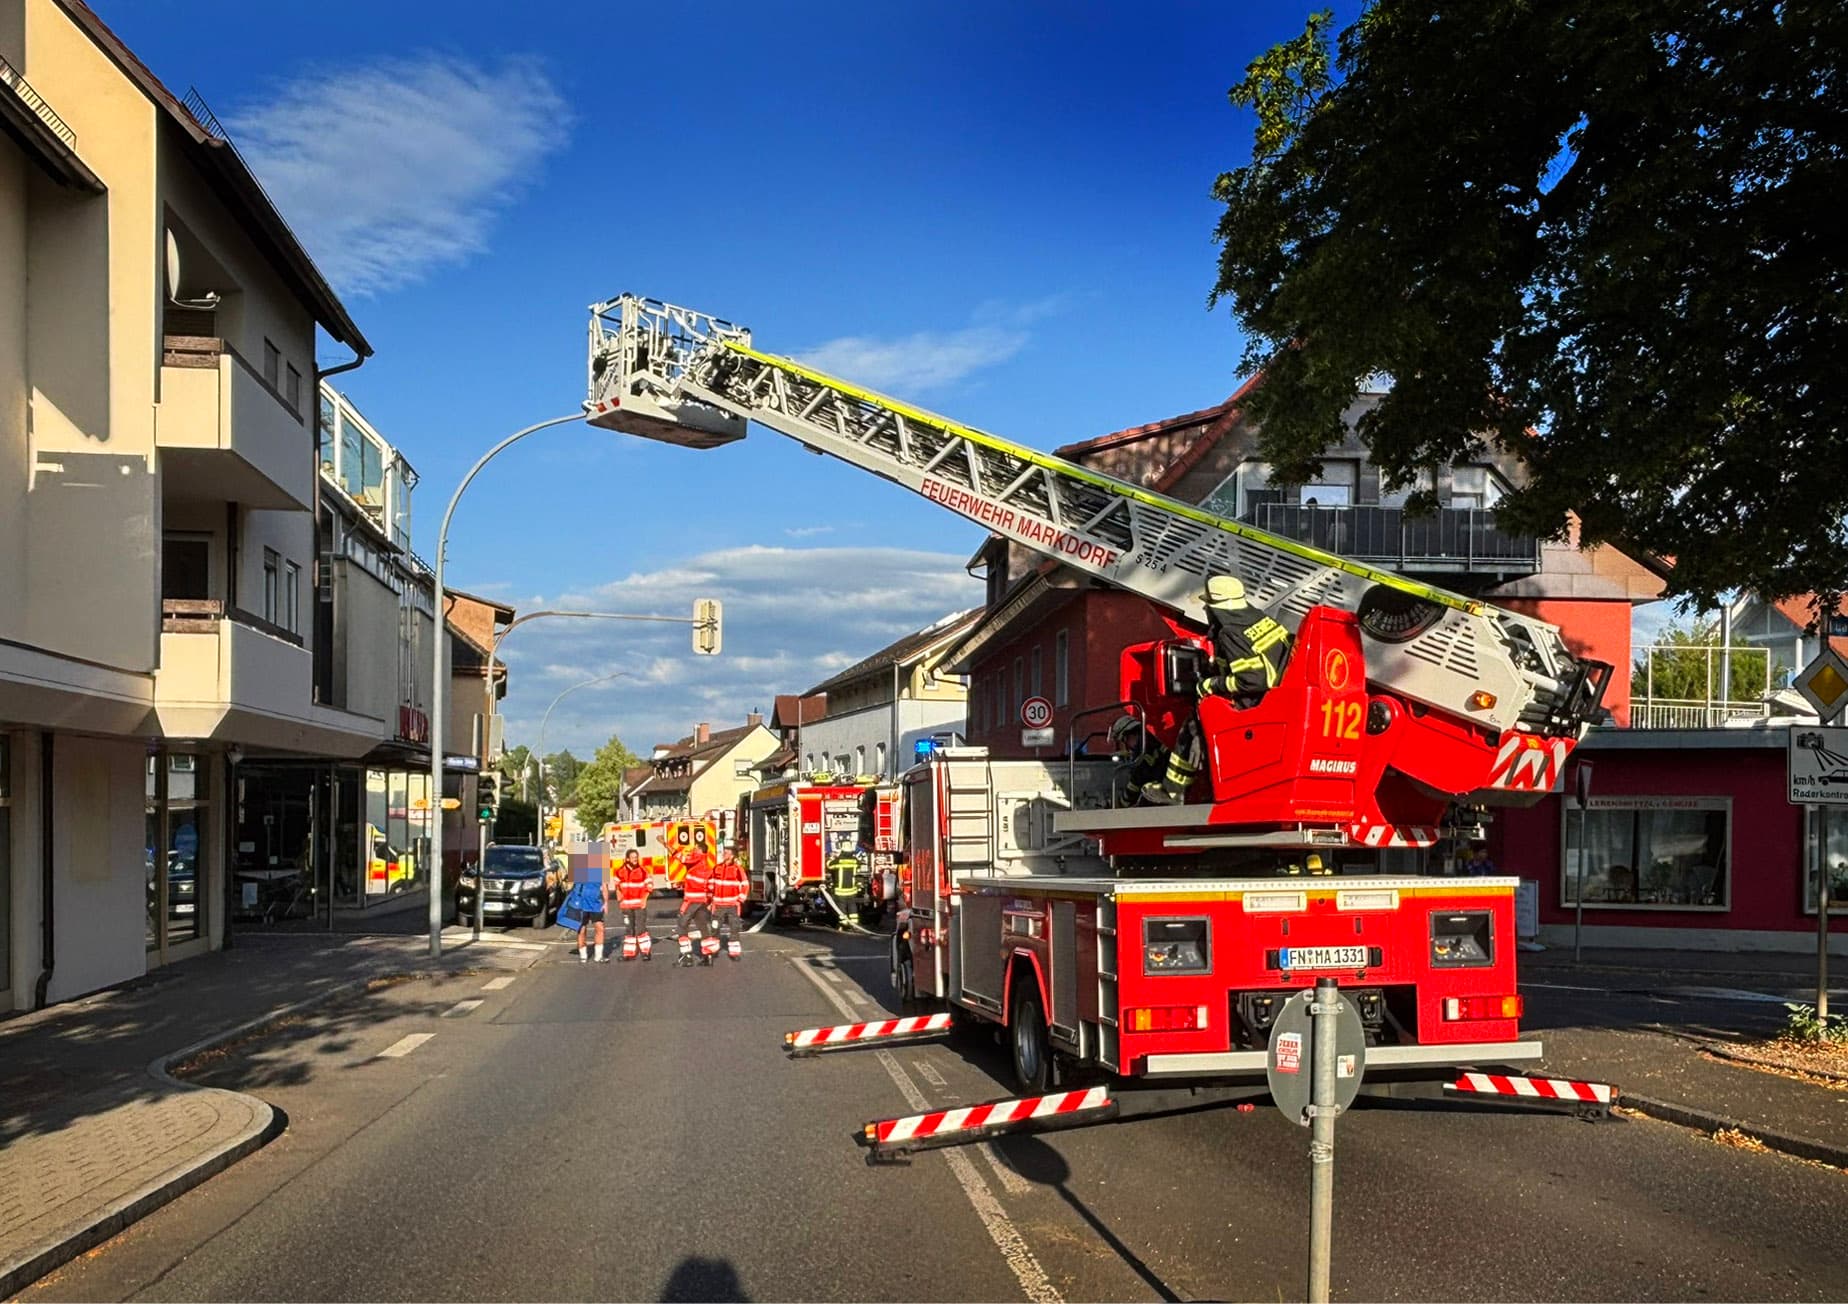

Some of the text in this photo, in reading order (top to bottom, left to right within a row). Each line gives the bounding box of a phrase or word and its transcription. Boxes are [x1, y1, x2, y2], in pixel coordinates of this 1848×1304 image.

[920, 478, 1118, 569] FEUERWEHR MARKDORF
[1028, 705, 1046, 720] 30
[1320, 698, 1363, 740] 112
[1309, 758, 1357, 774] MAGIRUS
[1793, 774, 1816, 786] km/h
[1289, 948, 1365, 965] FN MA 1331
